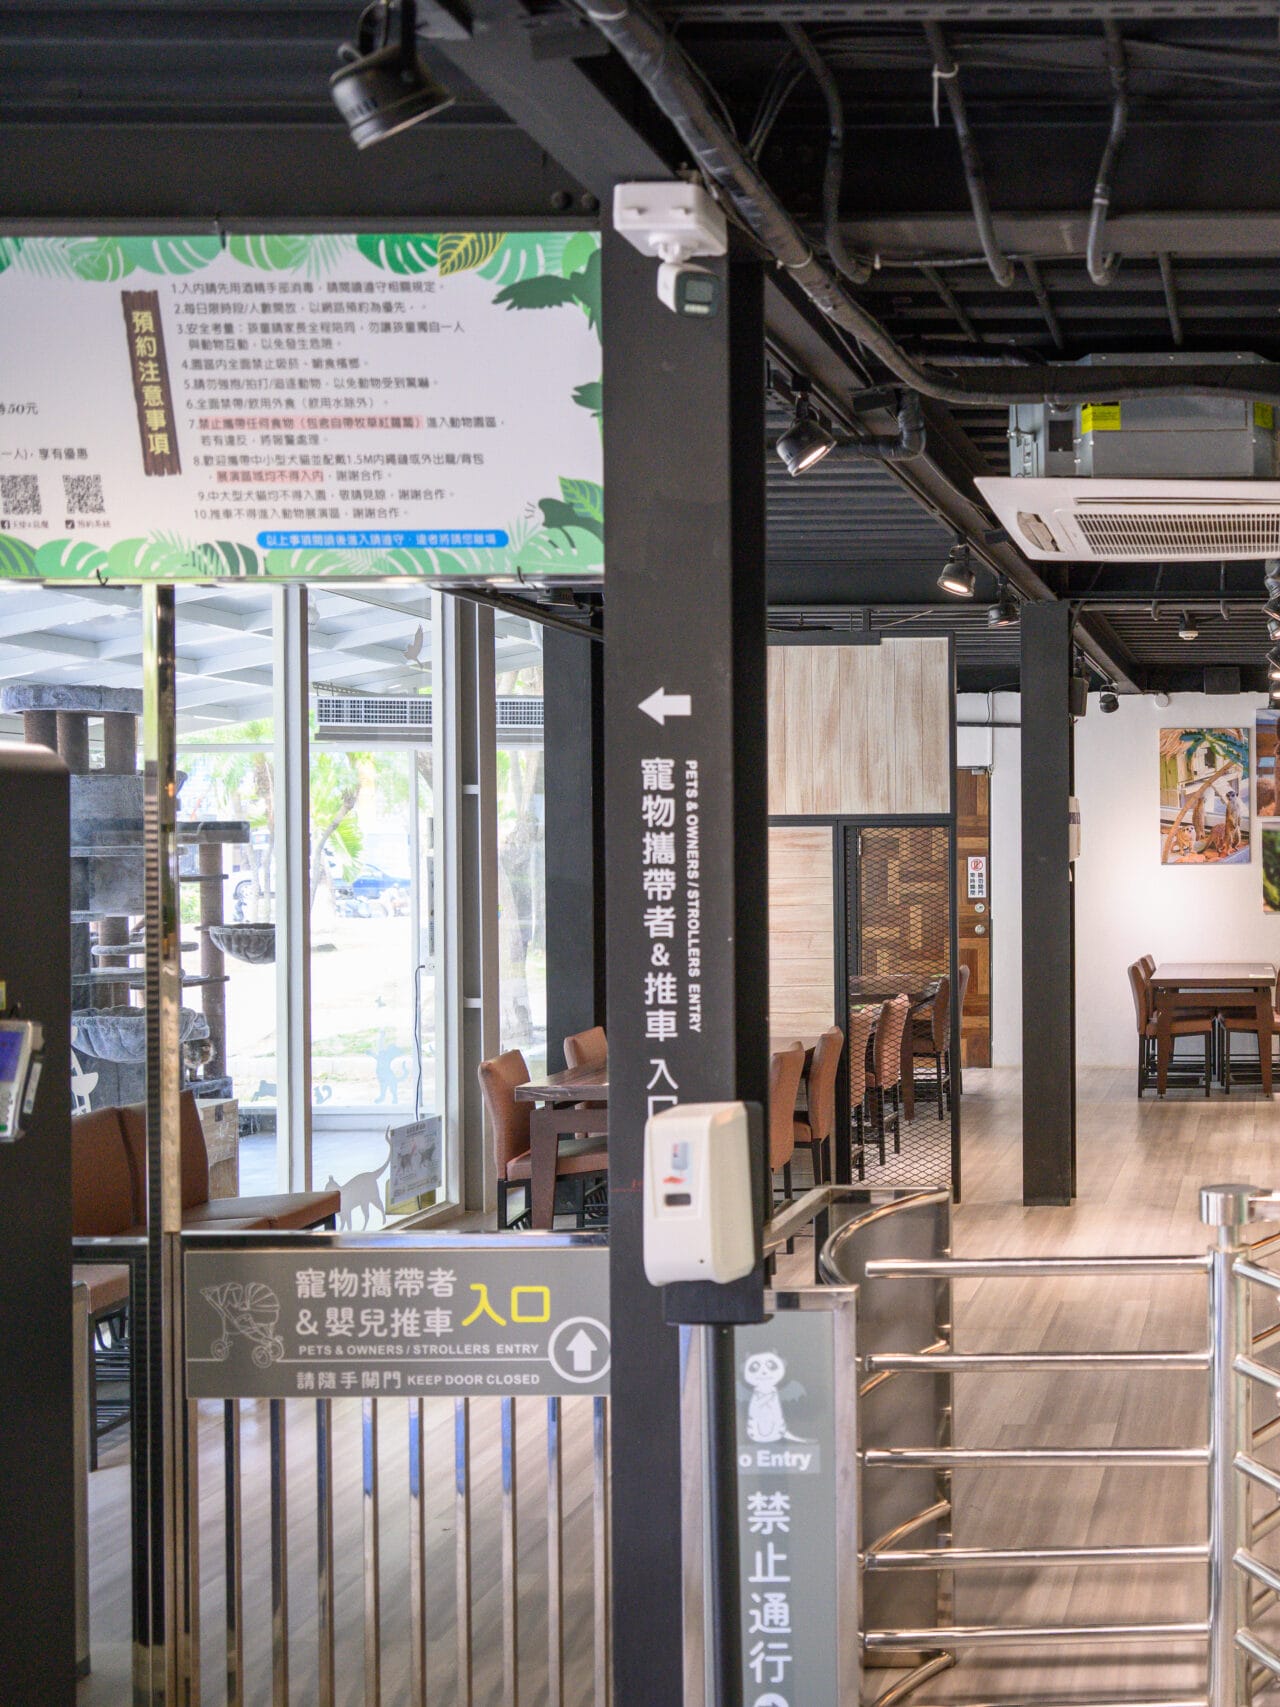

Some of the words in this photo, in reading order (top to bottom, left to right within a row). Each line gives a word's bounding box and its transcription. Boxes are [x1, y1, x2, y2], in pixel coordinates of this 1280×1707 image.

[131, 310, 170, 456] 預約注意事項
[685, 759, 698, 799] PETS
[686, 813, 699, 880] OWNERS
[687, 889, 700, 978] STROLLERS
[688, 983, 701, 1033] ENTRY
[295, 1267, 458, 1299] 寵物攜帶者
[461, 1283, 551, 1327] 入口
[298, 1344, 331, 1356] PETS
[335, 1344, 344, 1356] &
[347, 1344, 404, 1356] OWNERS
[413, 1344, 490, 1355] STROLLERS
[496, 1343, 540, 1355] ENTRY
[296, 1371, 401, 1390] 請隨手關門
[407, 1374, 443, 1386] KEEP
[445, 1374, 483, 1386] DOOR
[486, 1373, 540, 1385] CLOSED
[757, 1450, 811, 1472] Entry
[747, 1491, 793, 1684] 禁止通行
